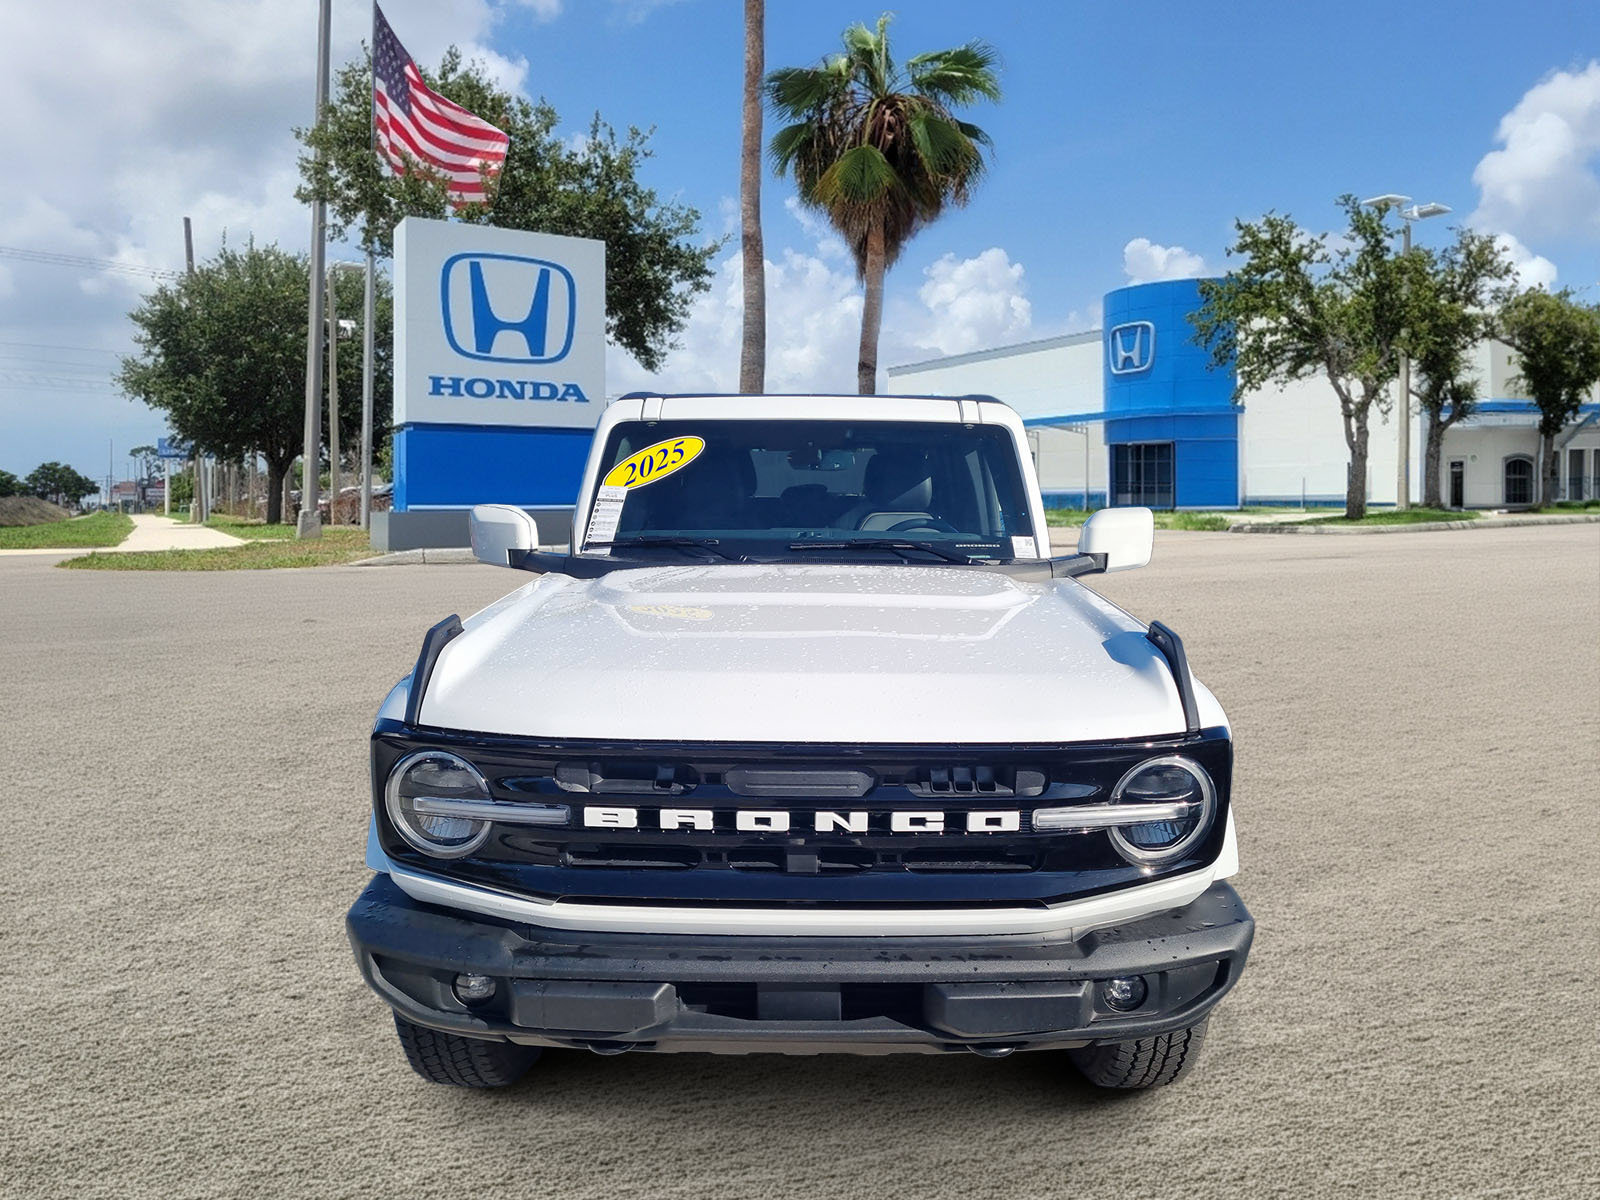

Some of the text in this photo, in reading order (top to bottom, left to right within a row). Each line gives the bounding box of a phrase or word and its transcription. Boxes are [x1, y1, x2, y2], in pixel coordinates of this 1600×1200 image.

[428, 375, 590, 403] HONDA
[623, 440, 685, 487] 2025
[583, 806, 1021, 832] BRONCO
